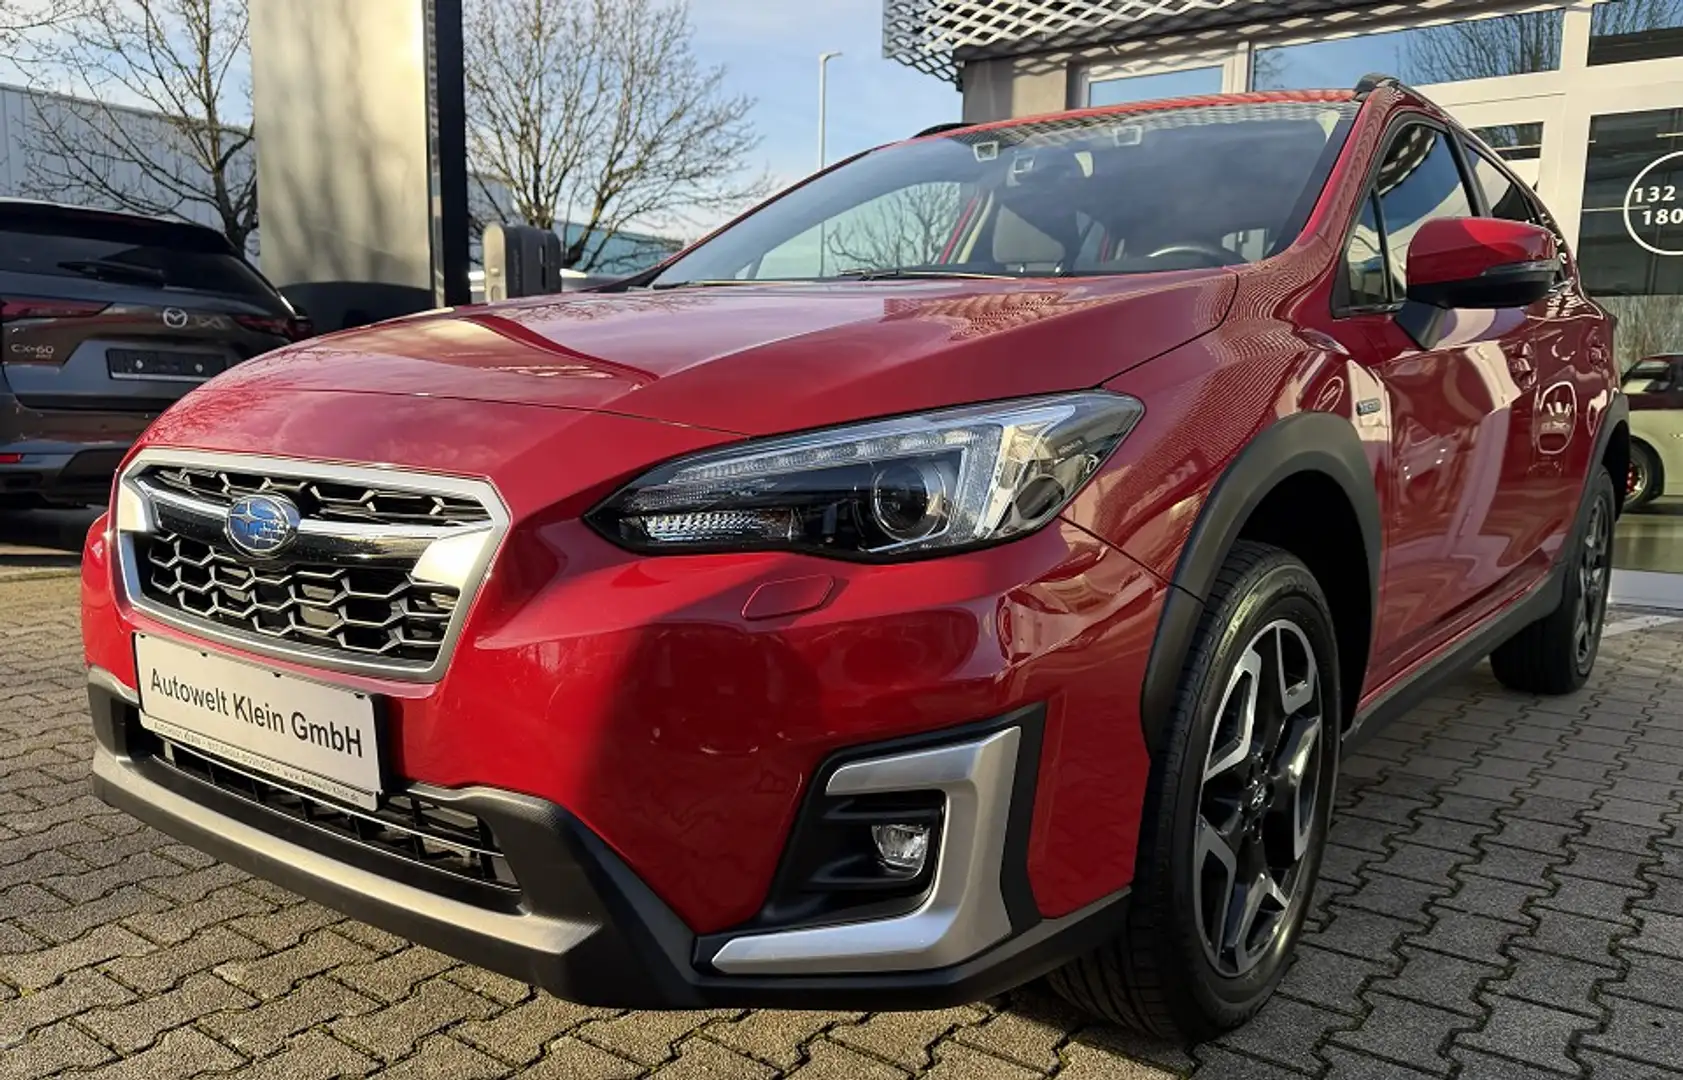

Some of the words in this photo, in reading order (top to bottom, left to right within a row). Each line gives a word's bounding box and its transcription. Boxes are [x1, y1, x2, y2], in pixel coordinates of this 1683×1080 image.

[1634, 185, 1676, 203] 132
[1642, 208, 1683, 226] 180
[151, 668, 229, 717] Autowelt
[232, 693, 285, 734] Klein
[291, 711, 363, 758] GmbH
